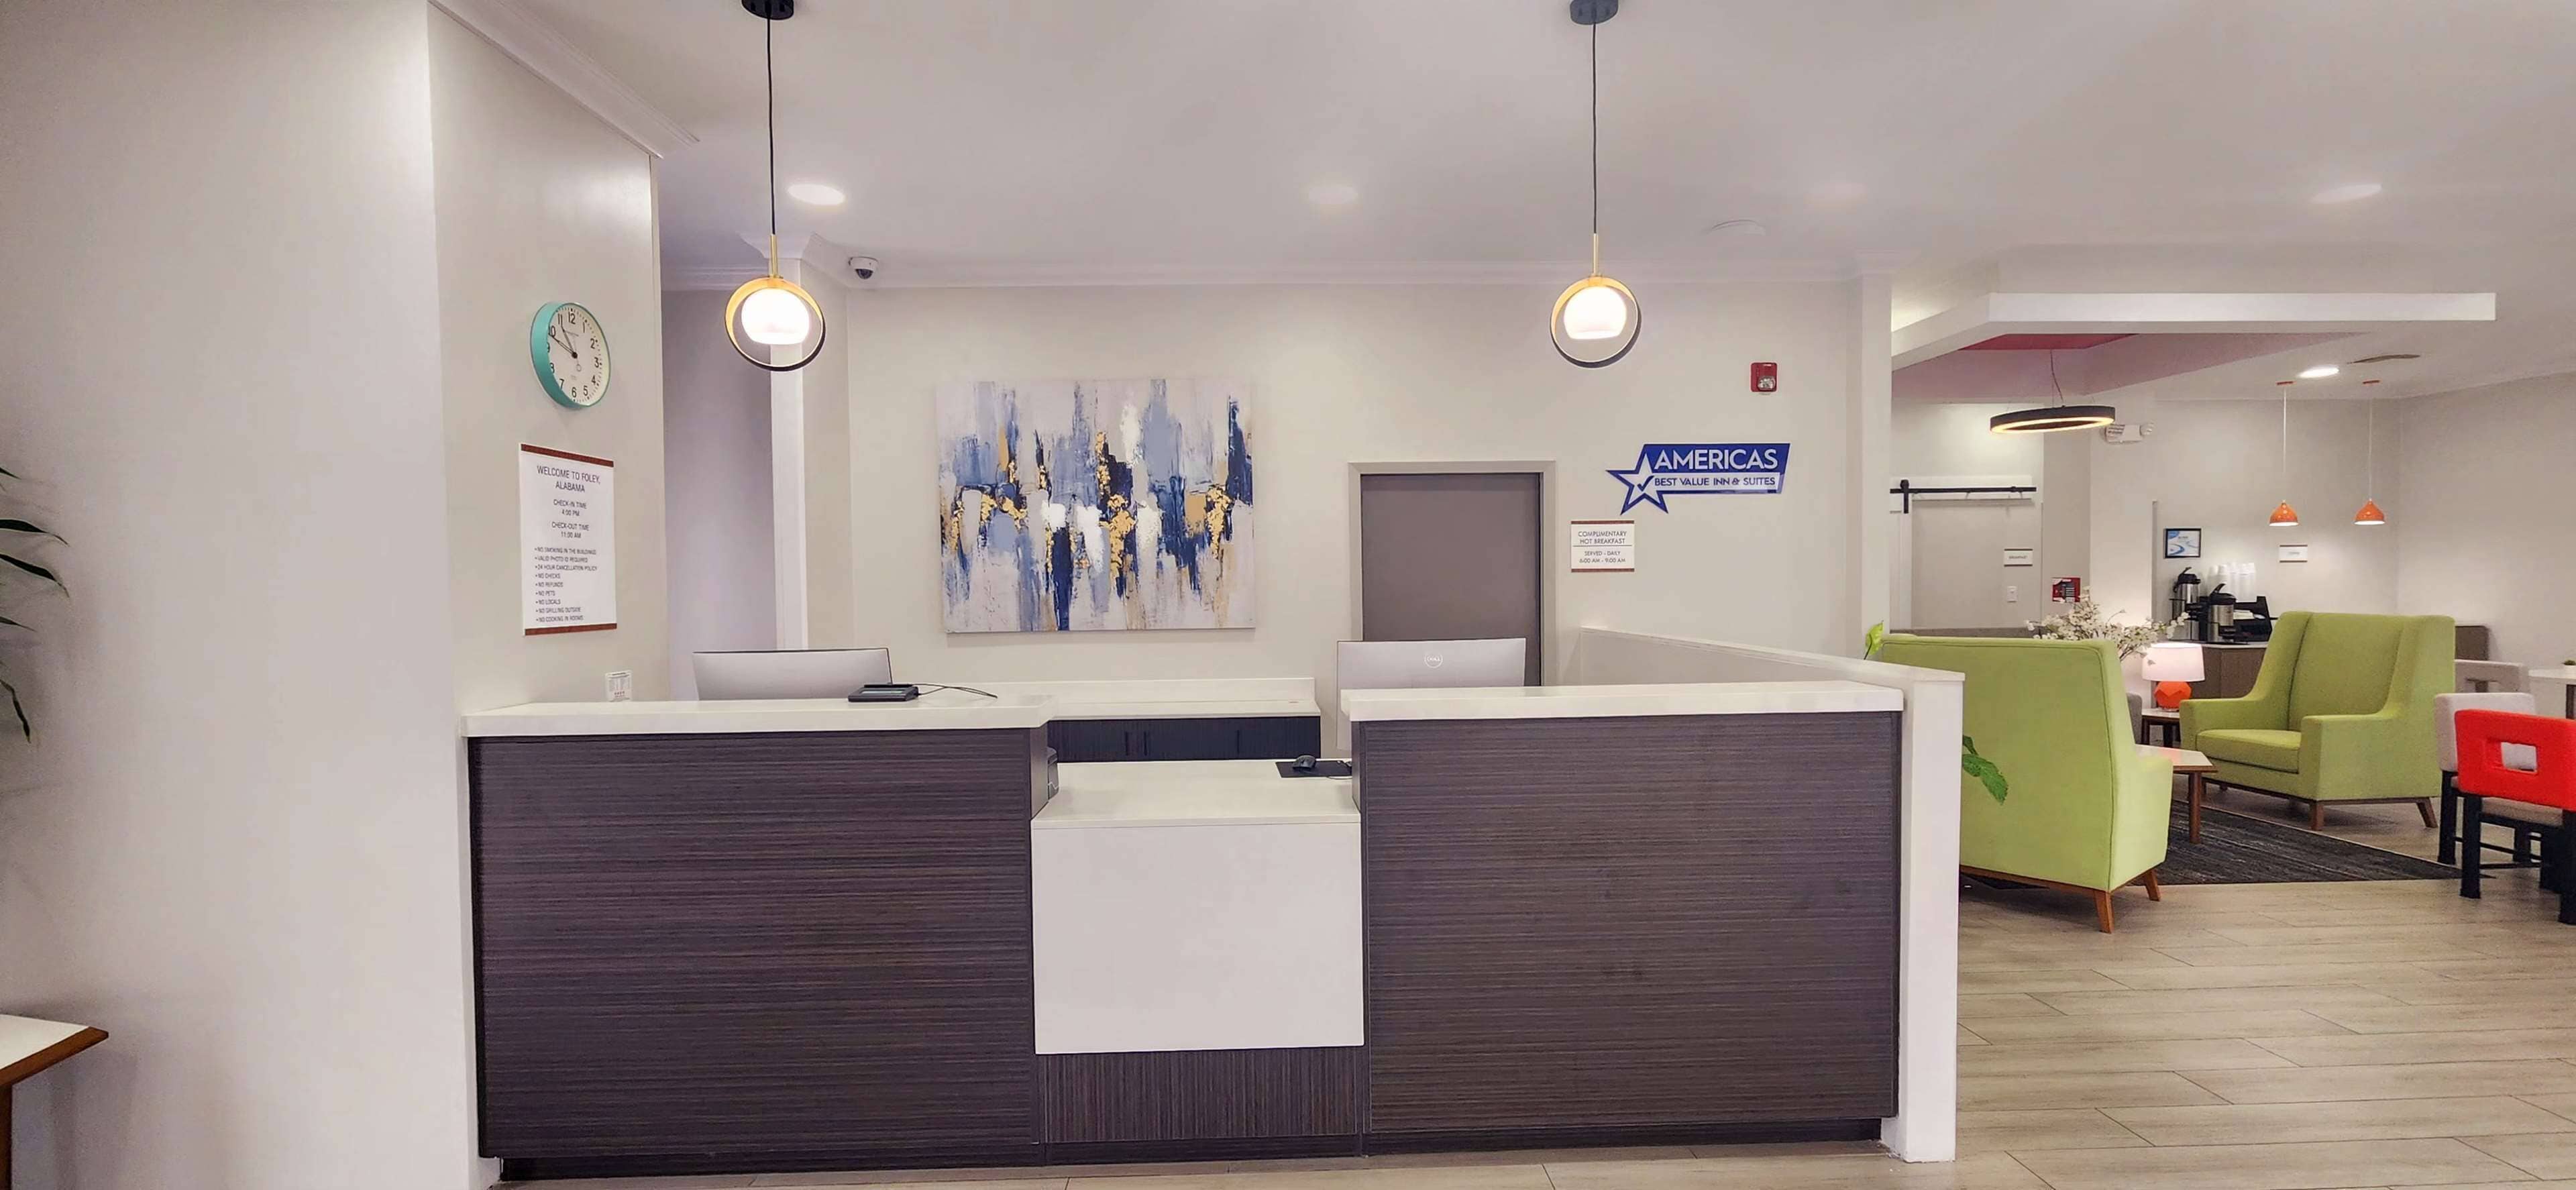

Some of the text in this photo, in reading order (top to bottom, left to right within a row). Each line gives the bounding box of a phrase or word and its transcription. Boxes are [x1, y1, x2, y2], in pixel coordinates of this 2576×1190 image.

[568, 311, 576, 325] 12
[582, 322, 586, 333] 1
[590, 338, 596, 349] 2
[594, 357, 599, 368] 3
[559, 378, 564, 390] 7
[591, 375, 596, 385] 4
[572, 387, 576, 398] 6
[584, 386, 588, 396] 5
[1654, 449, 1778, 470] AMERICAS
[537, 466, 600, 484] WELCOME TO FOLEY,
[555, 481, 585, 492] ALABAMA
[1654, 478, 1676, 486] BEST
[1679, 478, 1709, 486] VALUE
[1713, 478, 1730, 486] INN
[1743, 477, 1775, 486] SUITES
